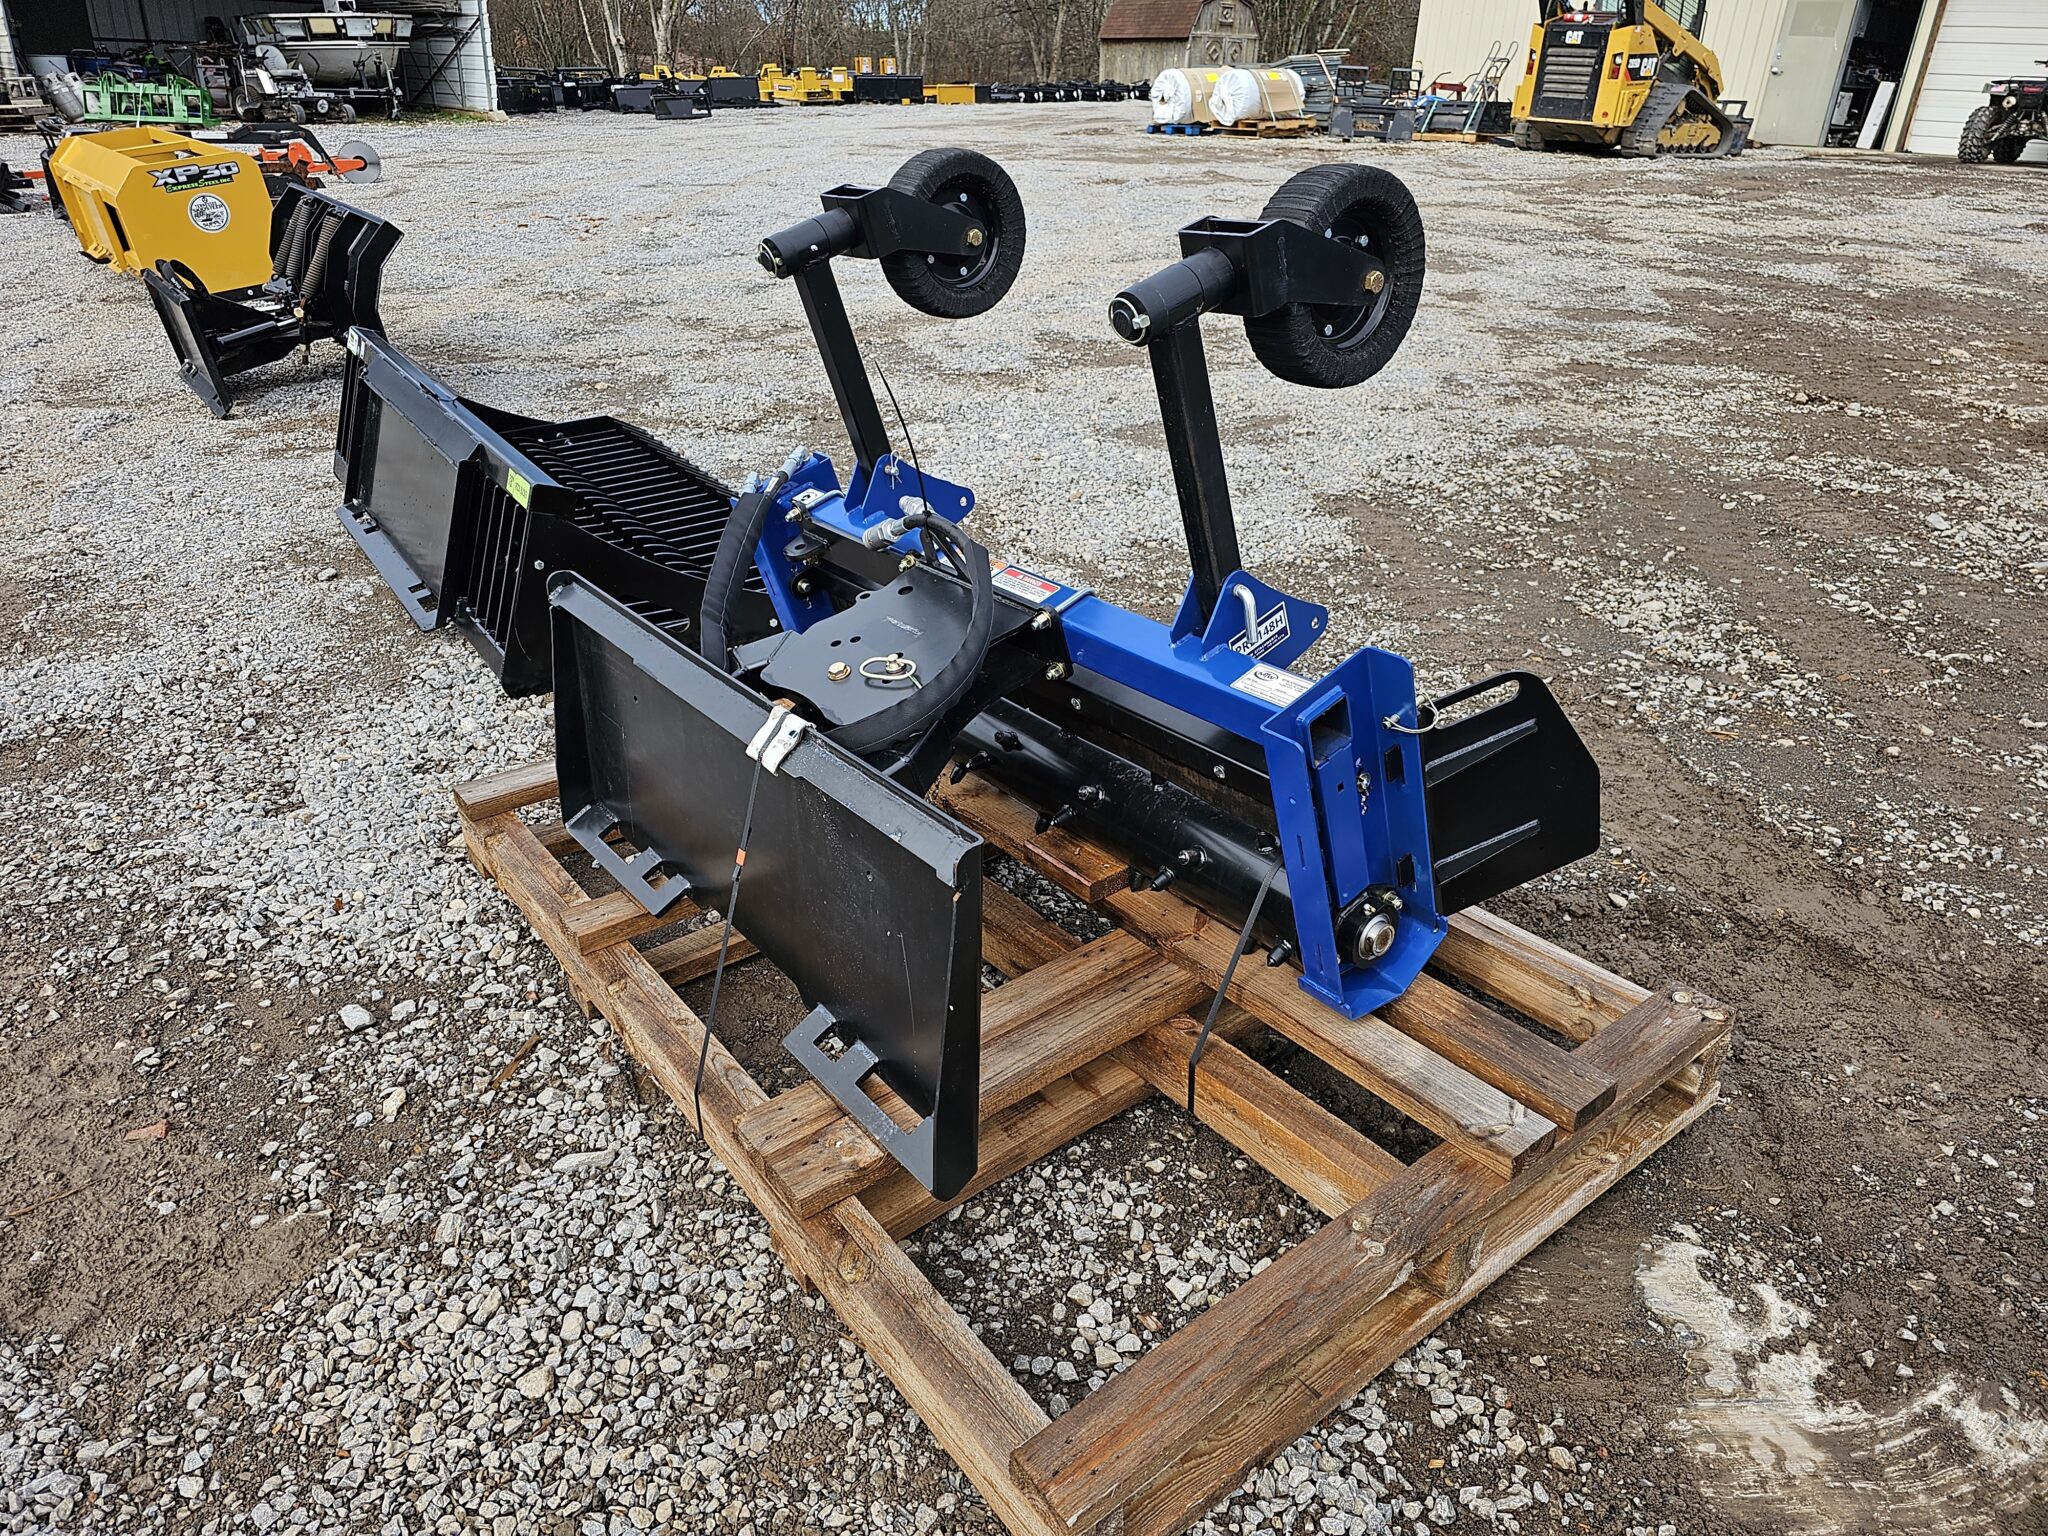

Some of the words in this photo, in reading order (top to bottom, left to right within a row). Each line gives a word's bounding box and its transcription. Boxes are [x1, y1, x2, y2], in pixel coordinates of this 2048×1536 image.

[1565, 30, 1584, 44] CAT
[1640, 57, 1658, 77] CAT
[147, 161, 240, 188] XP30
[1235, 614, 1284, 653] PR148H
